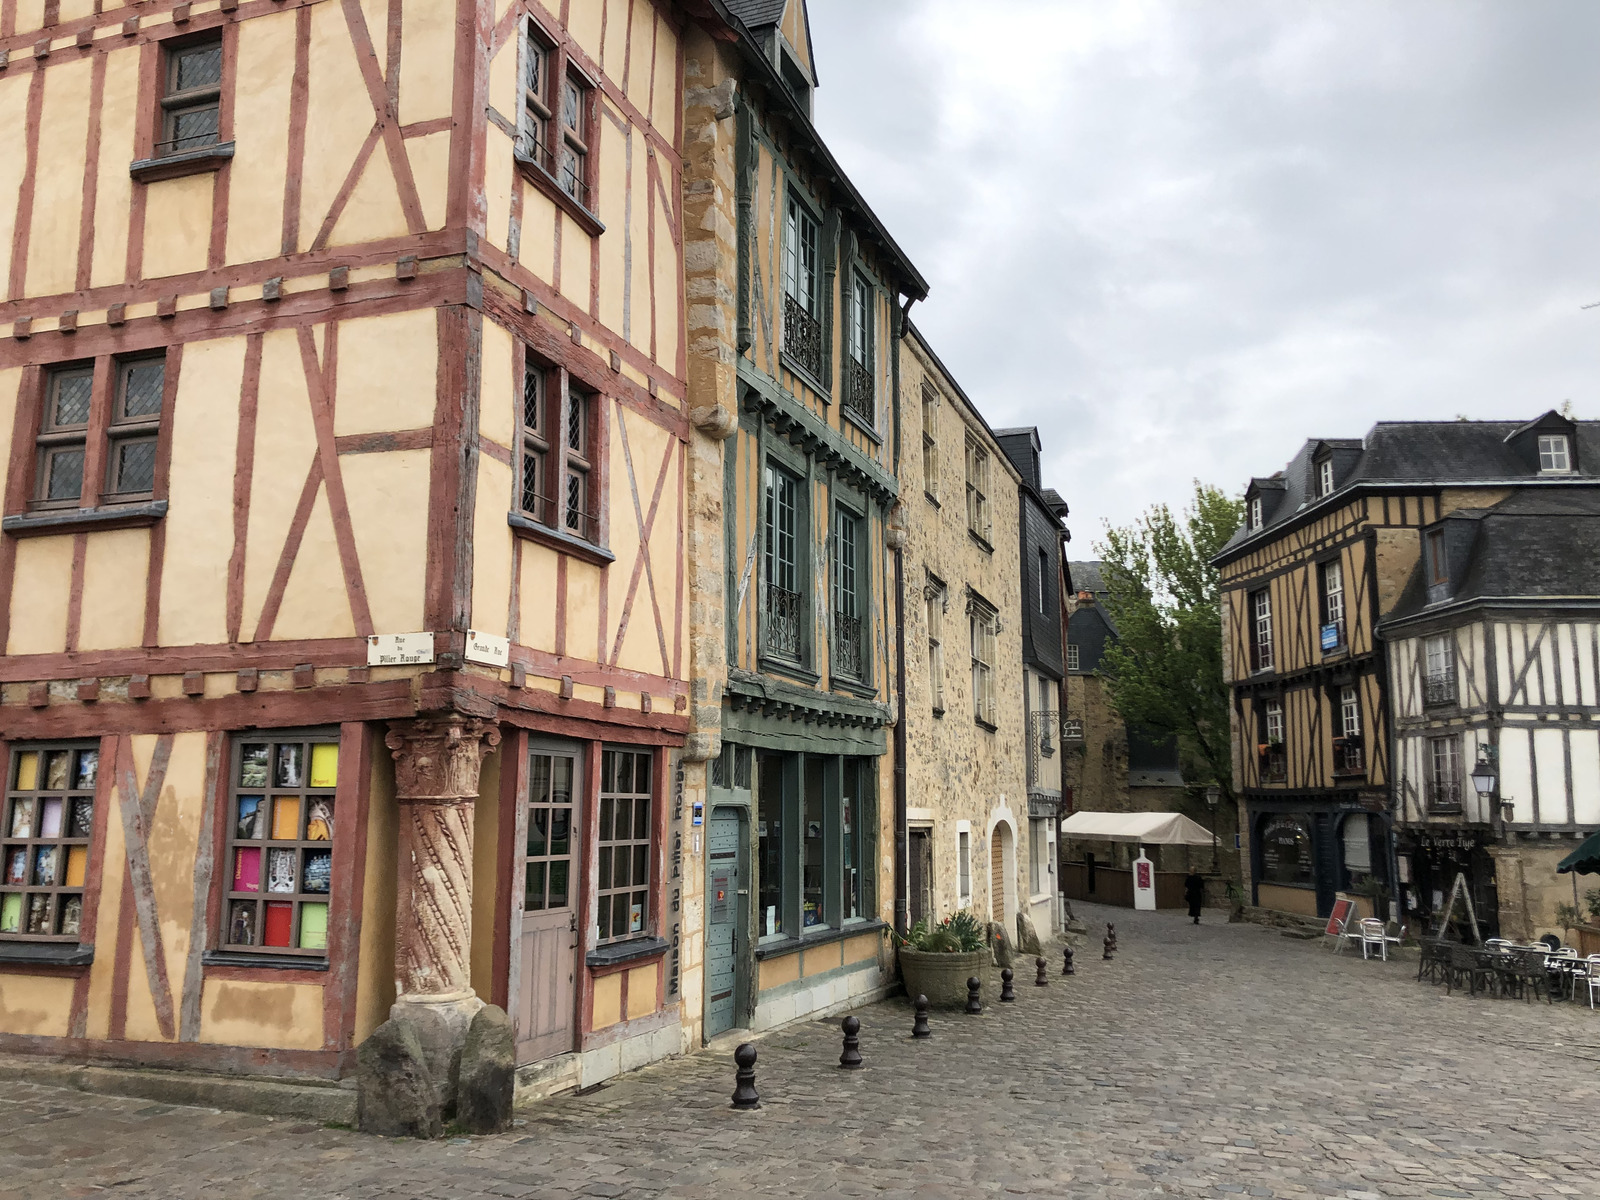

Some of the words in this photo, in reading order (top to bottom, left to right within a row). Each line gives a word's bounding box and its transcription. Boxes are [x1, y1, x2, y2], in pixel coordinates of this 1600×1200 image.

[394, 636, 406, 644] Rue
[473, 642, 490, 654] Grande
[494, 646, 503, 656] Rue
[379, 654, 397, 664] Pilier
[400, 654, 421, 663] Rouge
[674, 758, 685, 820] Rouge
[671, 831, 682, 878] Pilier
[672, 888, 680, 912] du
[670, 922, 680, 995] Maison
